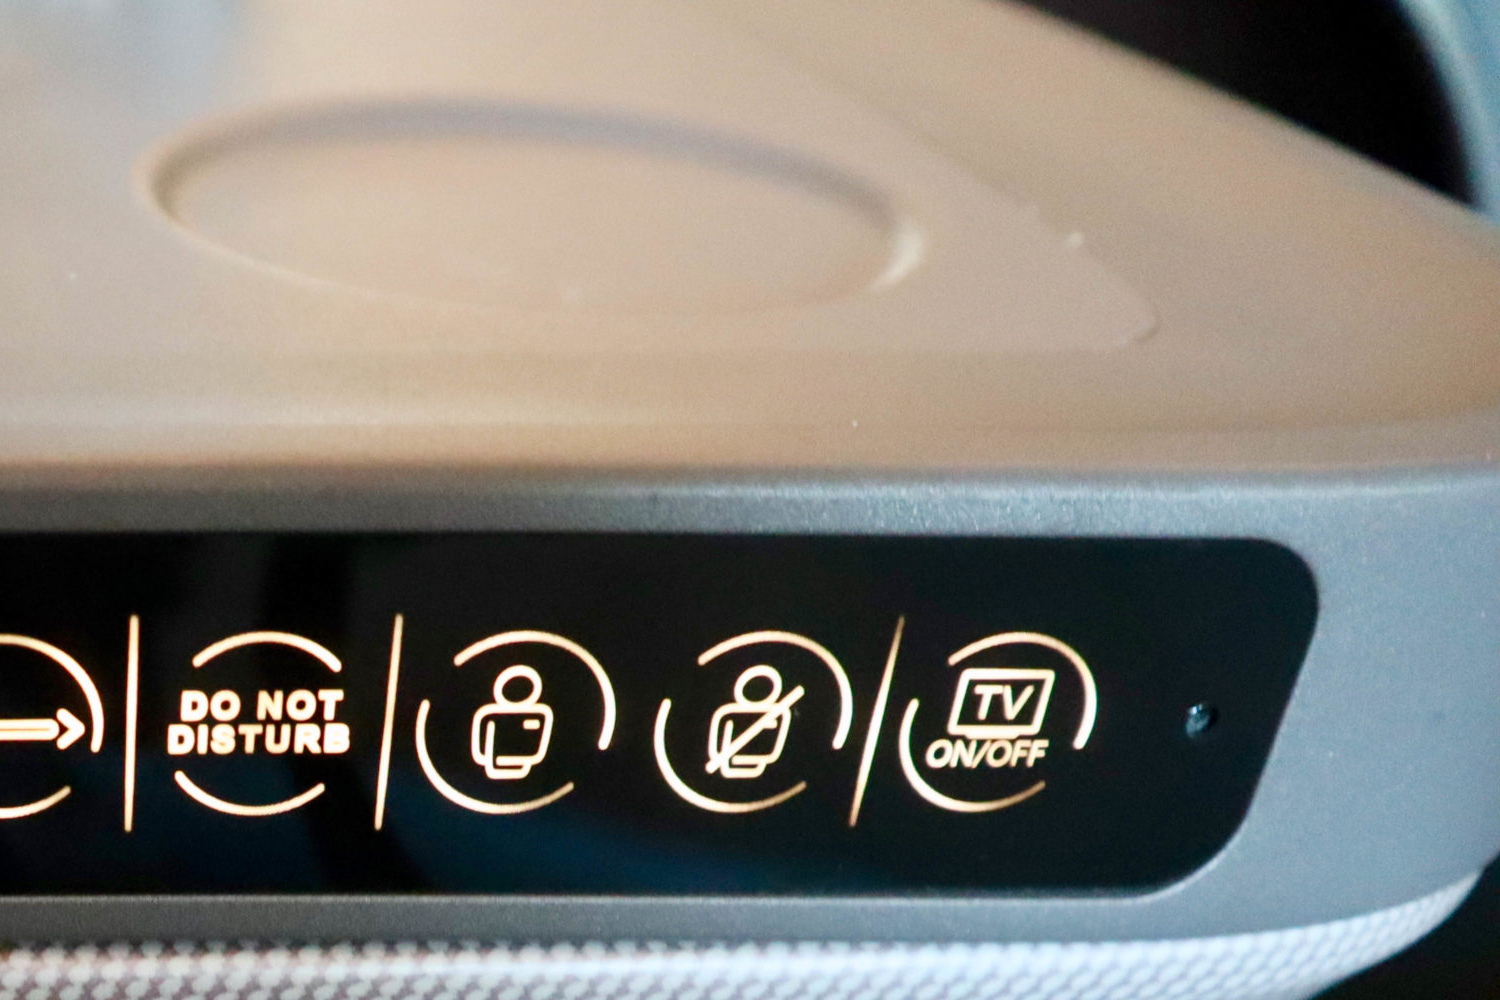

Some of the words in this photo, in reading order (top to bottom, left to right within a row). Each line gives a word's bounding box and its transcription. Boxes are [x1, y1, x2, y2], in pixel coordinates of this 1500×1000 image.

[180, 689, 241, 722] DO
[257, 689, 344, 721] NOT
[974, 684, 1035, 721] TV
[167, 722, 350, 755] DISTURB
[925, 738, 1049, 769] ON/OFF
